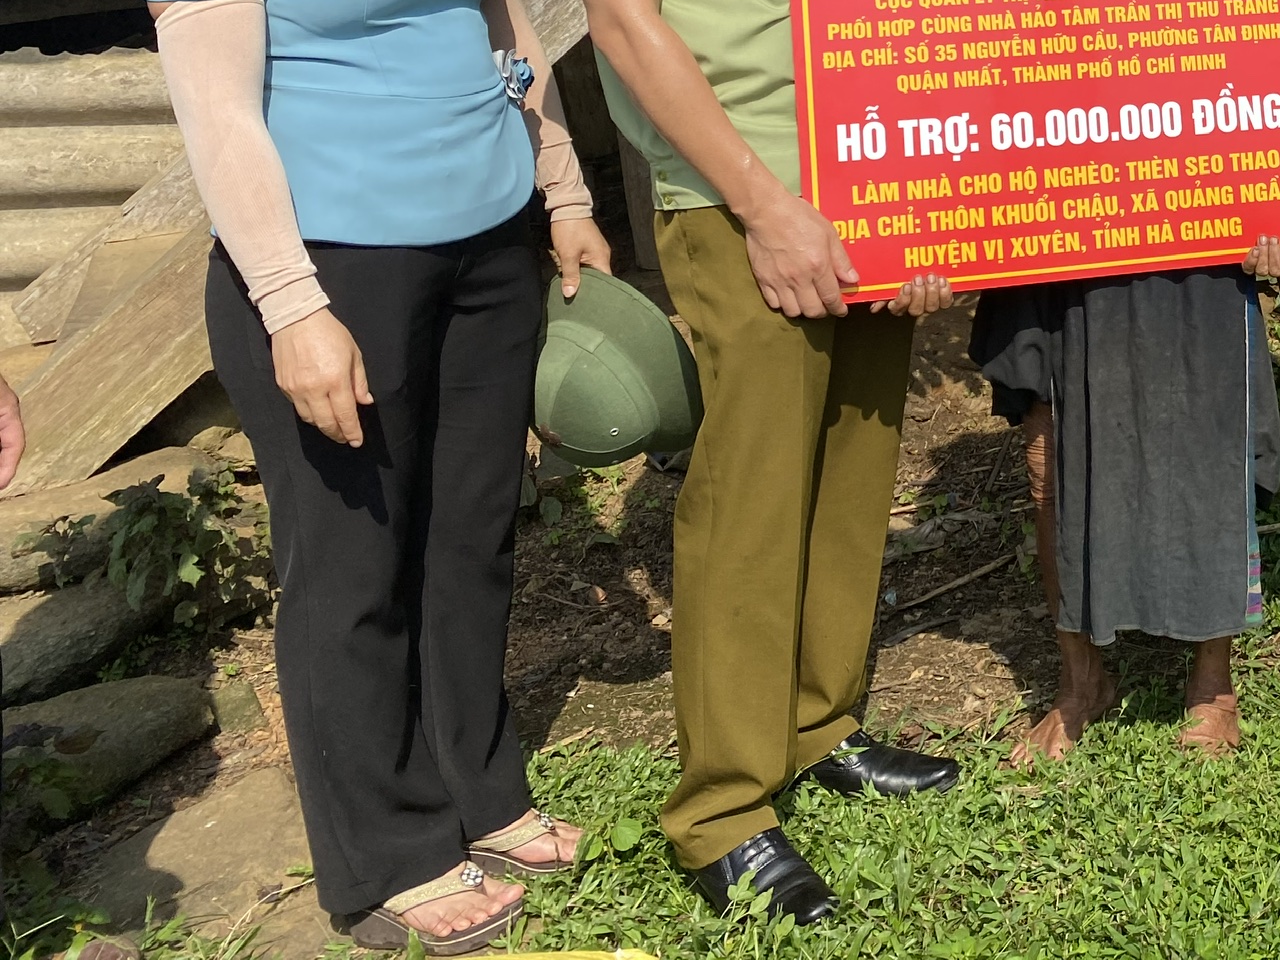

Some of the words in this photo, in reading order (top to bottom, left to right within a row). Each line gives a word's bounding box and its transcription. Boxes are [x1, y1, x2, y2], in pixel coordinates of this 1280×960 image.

[828, 16, 873, 41] PHỐI
[878, 18, 916, 38] HỢP
[922, 14, 973, 35] CÙNG
[978, 10, 1017, 32] NHÀ
[1021, 4, 1057, 29] HẢO
[1062, 6, 1101, 26] TÂM
[1105, 0, 1151, 24] TRẦN
[1155, 3, 1183, 23] THỊ
[1187, 1, 1220, 19] THU
[823, 50, 856, 72] ĐỊA
[861, 42, 899, 67] CHỈ:
[904, 40, 930, 64] SỐ
[935, 44, 958, 62] 35
[963, 34, 1037, 60] NGUYỄN
[1041, 33, 1077, 55] HỮU
[1083, 29, 1124, 52] CẦU,
[1128, 22, 1199, 49] PHƯỜNG
[1203, 24, 1237, 44] TÂN
[897, 70, 949, 95] QUẬN
[954, 63, 1008, 88] NHẤT,
[1012, 63, 1072, 84] THÀNH
[1077, 56, 1113, 80] PHỐ
[1118, 54, 1142, 77] HỒ
[1147, 54, 1176, 75] CHÍ
[1181, 53, 1227, 72] MINH
[837, 105, 887, 163] HỖ
[898, 112, 980, 162] TRỢ:
[991, 101, 1183, 151] 60.000.000
[852, 180, 900, 206] LÀM
[907, 173, 953, 201] NHÀ
[959, 173, 1003, 196] CHO
[1009, 166, 1038, 195] HỘ
[1043, 161, 1121, 189] NGHÈO:
[1126, 156, 1179, 182] THÈN
[1185, 155, 1224, 178] SEO
[1229, 150, 1280, 173] THAO
[833, 219, 871, 245] ĐỊA
[878, 206, 922, 237] CHỈ:
[927, 205, 985, 232] THÔN
[992, 194, 1057, 227] KHUỔI
[1063, 193, 1125, 222] CHẬU,
[1131, 189, 1160, 214] XÃ
[1165, 182, 1235, 212] QUẢNG
[905, 239, 977, 269] HUYỆN
[983, 239, 1004, 264] VỊ
[1011, 230, 1087, 258] XUYÊN,
[1092, 222, 1141, 250] TỈNH
[1147, 219, 1175, 245] HÀ
[1181, 217, 1243, 241] GIANG
